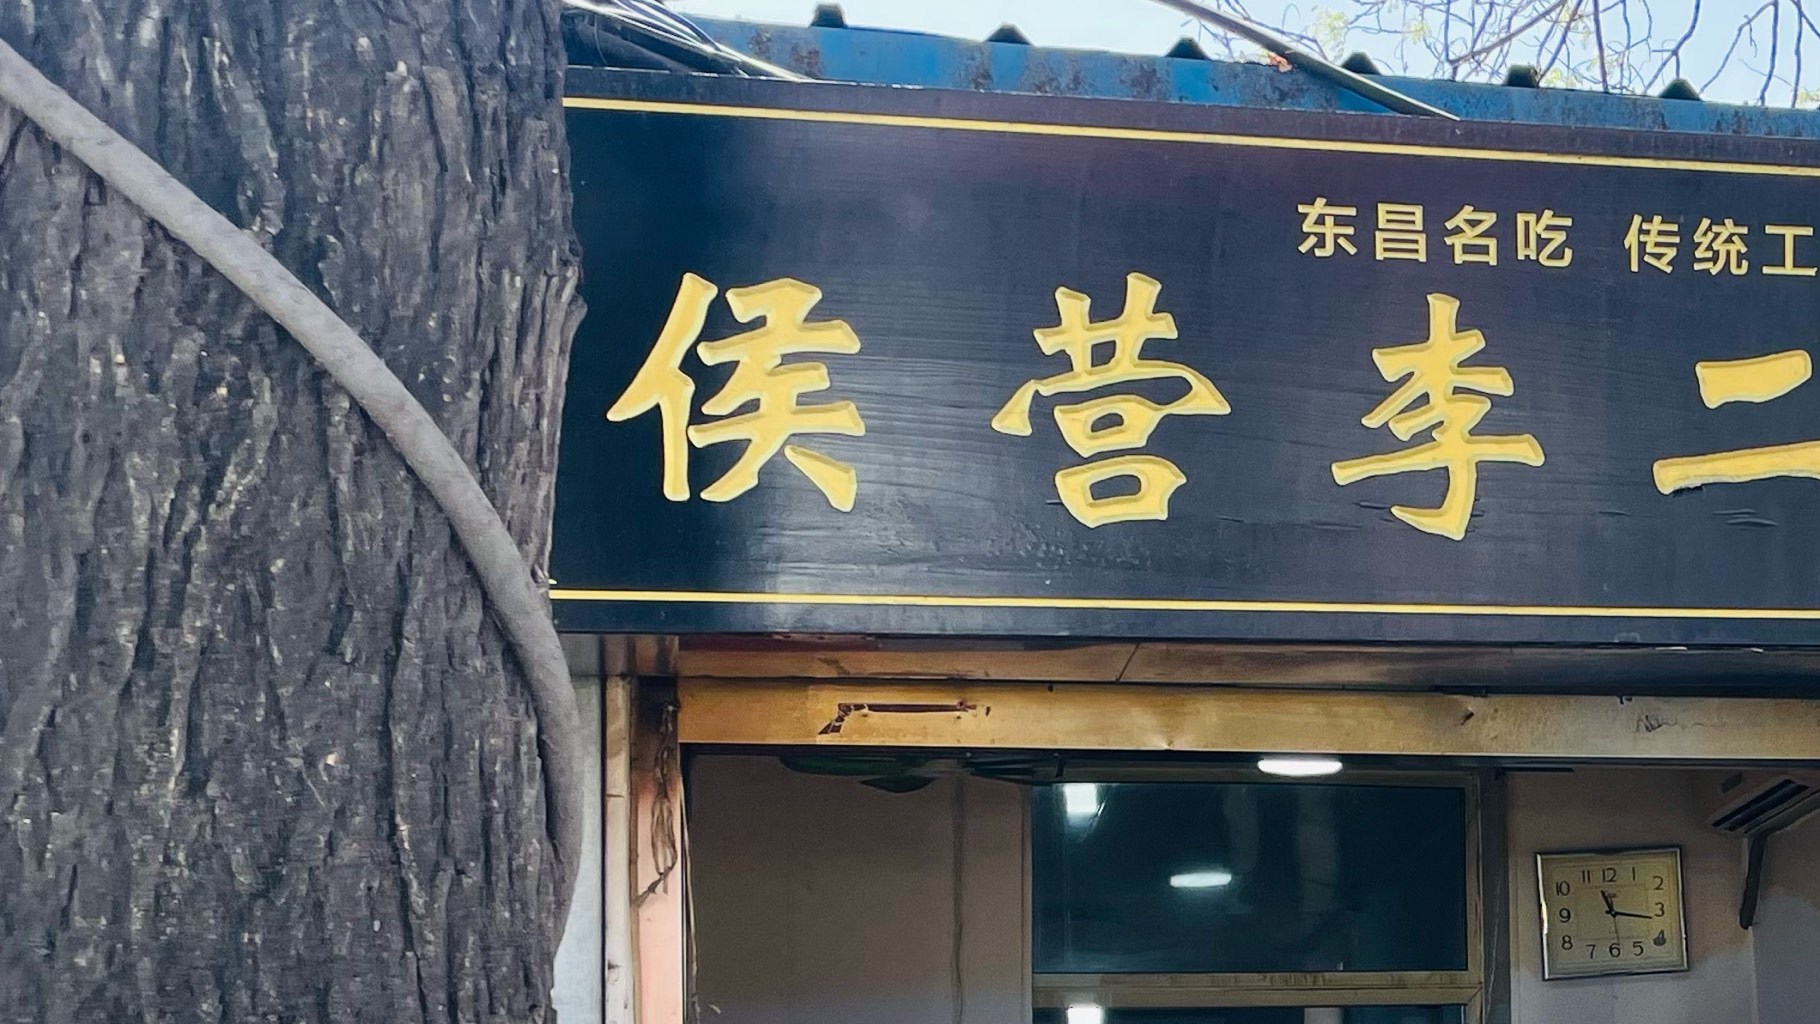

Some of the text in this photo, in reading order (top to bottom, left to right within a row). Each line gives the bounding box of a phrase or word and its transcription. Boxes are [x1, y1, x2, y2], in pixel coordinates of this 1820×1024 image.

[1297, 197, 1574, 267] 东昌名吃
[1581, 869, 1591, 884] 11
[1602, 867, 1617, 883] 12
[1631, 866, 1637, 881] 1
[1555, 880, 1571, 896] 10
[1652, 875, 1664, 891] 2
[1558, 907, 1571, 923] 9
[1653, 902, 1665, 918] 3
[1560, 934, 1573, 951] 8
[1608, 942, 1621, 958] 6
[1632, 941, 1644, 957] 5
[1586, 944, 1596, 960] 7
